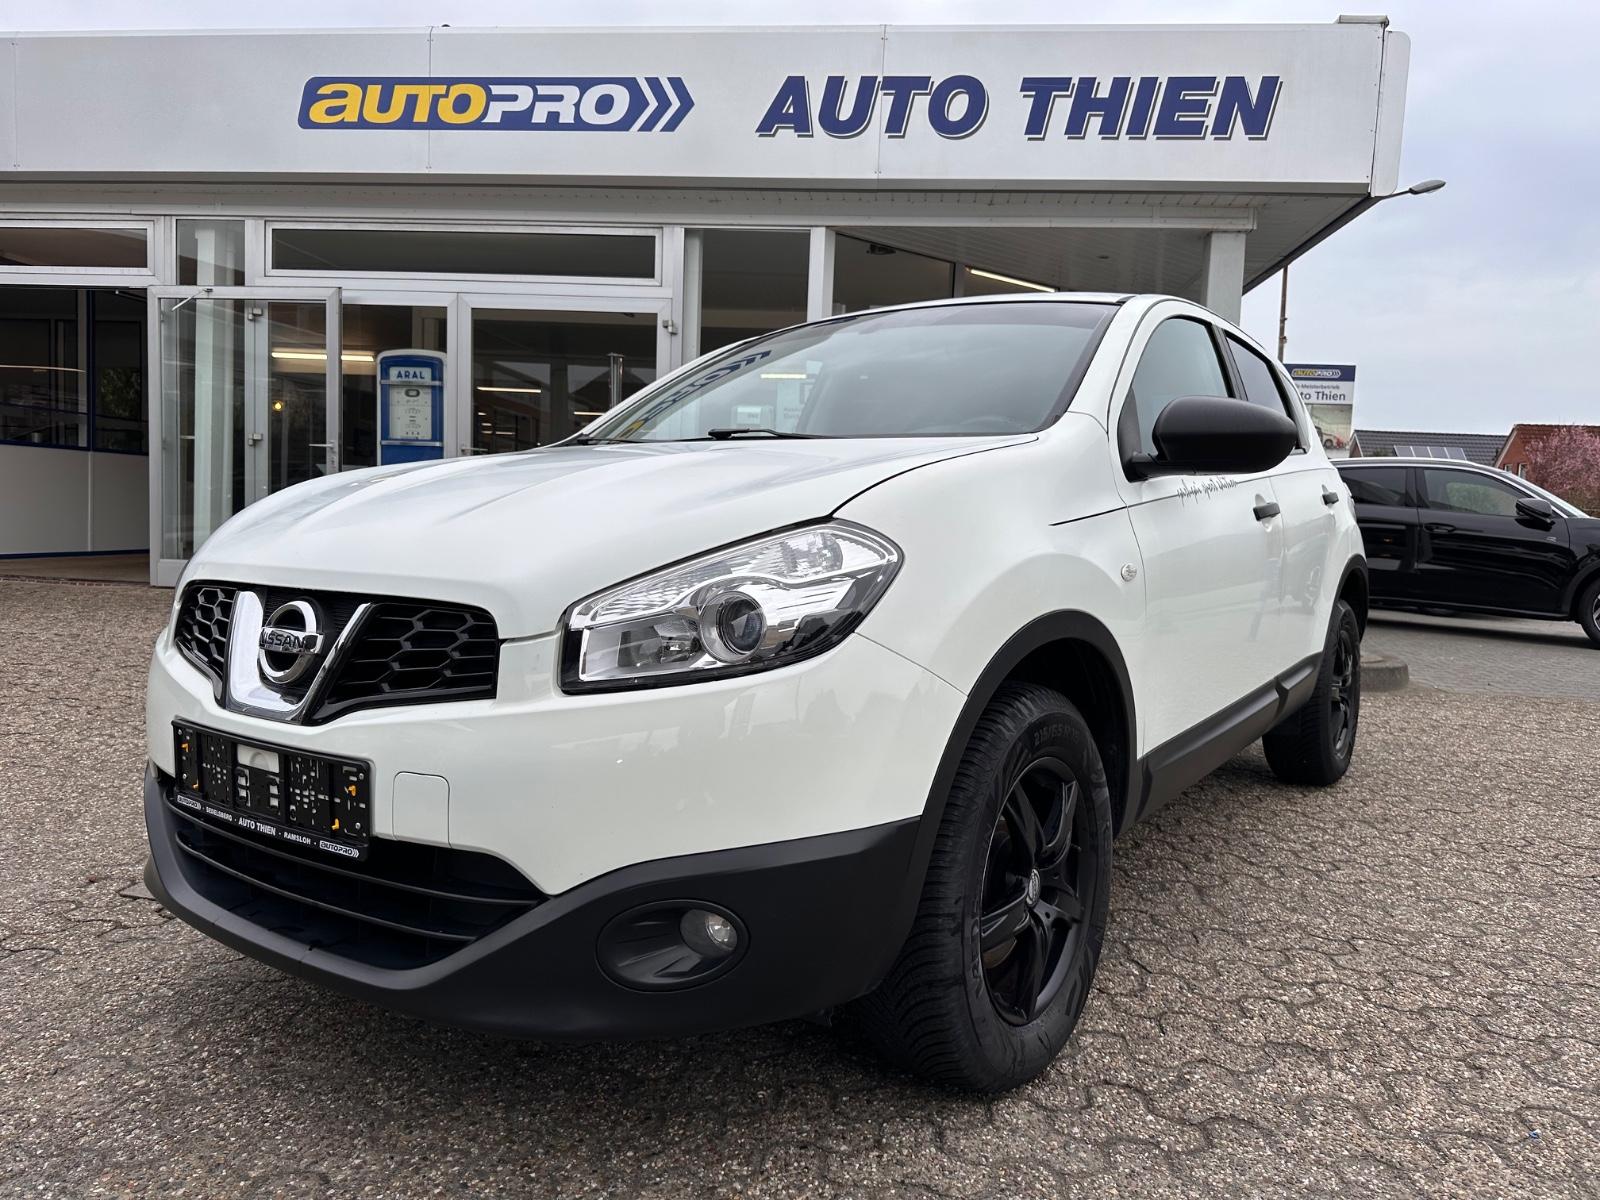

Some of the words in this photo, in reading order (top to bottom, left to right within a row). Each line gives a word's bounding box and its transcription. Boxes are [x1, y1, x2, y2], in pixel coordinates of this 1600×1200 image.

[755, 74, 990, 140] AUTO
[1018, 75, 1283, 141] THIEN
[396, 370, 425, 380] ARAL
[1300, 391, 1312, 401] to
[1315, 391, 1346, 401] Thien
[259, 629, 305, 648] NISSAN
[238, 816, 256, 829] AUTO
[256, 822, 276, 836] THIEN
[283, 832, 312, 844] RAMSLOH
